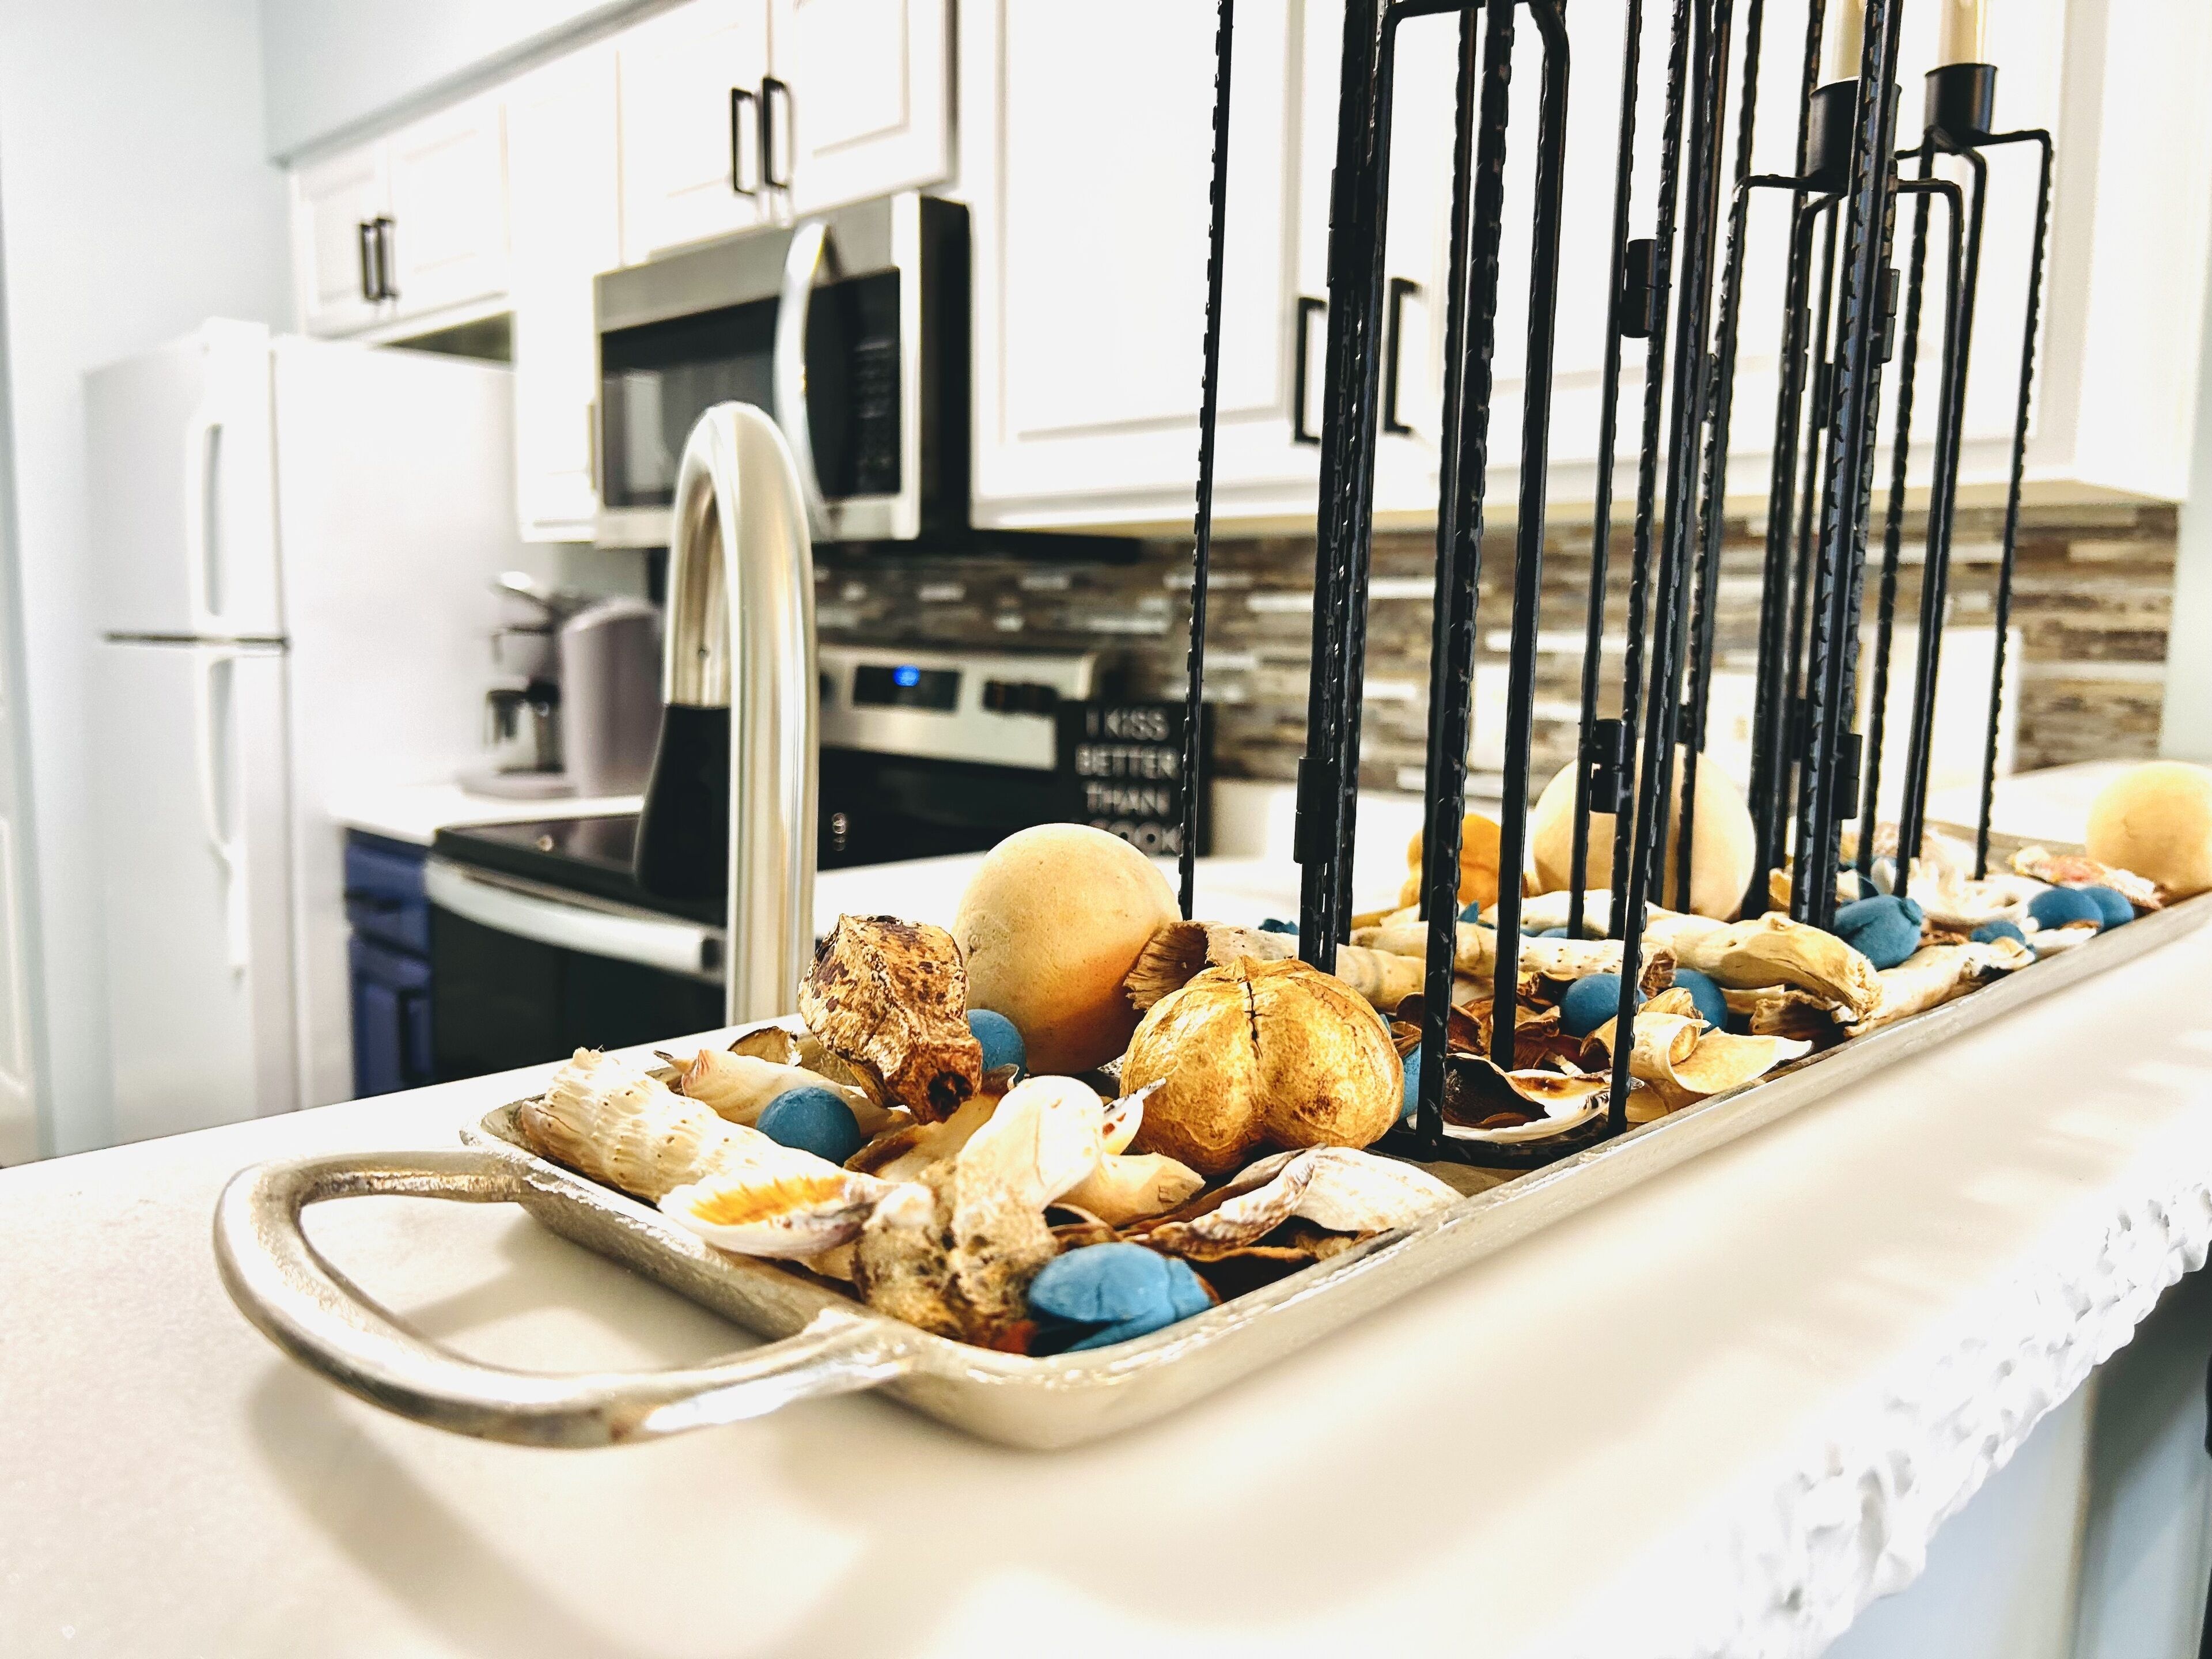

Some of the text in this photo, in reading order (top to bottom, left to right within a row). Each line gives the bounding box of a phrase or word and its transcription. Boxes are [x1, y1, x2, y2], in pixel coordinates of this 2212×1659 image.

[1086, 707, 1169, 741] I KISS
[1075, 744, 1179, 779] BETTER
[1082, 781, 1171, 816] THAN
[1089, 819, 1182, 855] OOK
